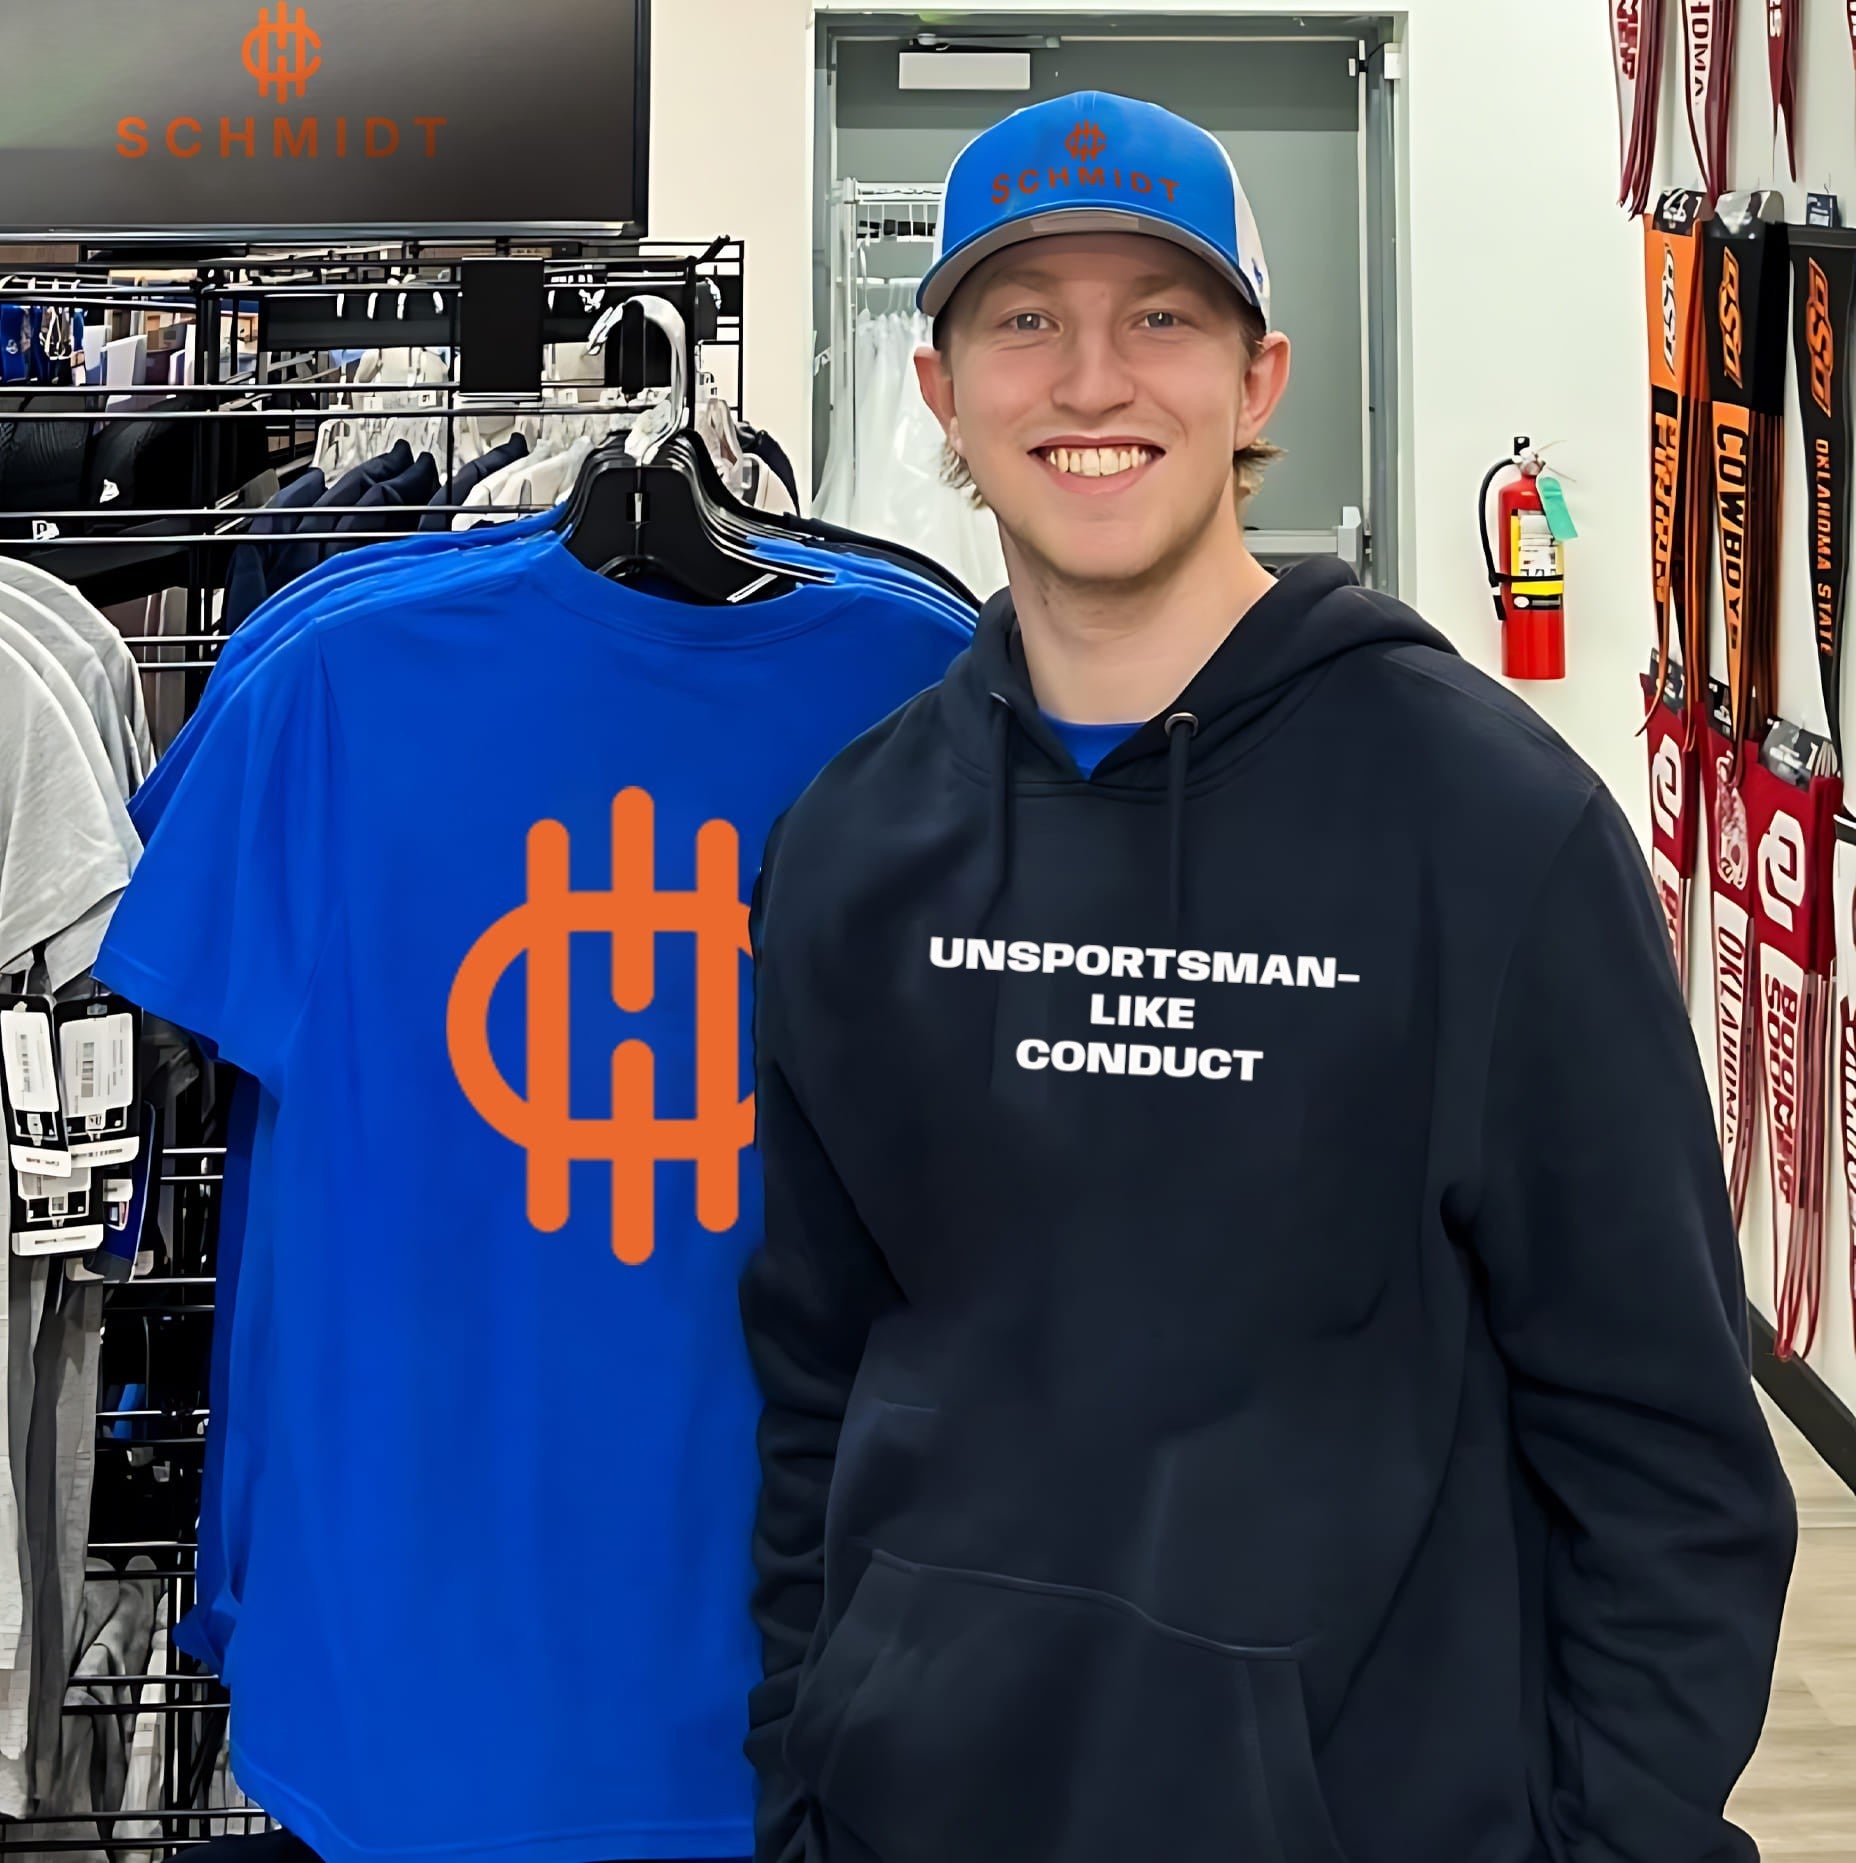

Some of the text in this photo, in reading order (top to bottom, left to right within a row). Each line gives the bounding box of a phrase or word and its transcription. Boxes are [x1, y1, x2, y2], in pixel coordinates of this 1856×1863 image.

[115, 116, 447, 159] SCHMIDT
[991, 167, 1179, 205] SCHMIDT
[1815, 438, 1832, 570] OKLAHOMA
[1716, 423, 1748, 650] COWBOY
[929, 936, 1360, 989] UNSPORTSMAN-
[1090, 993, 1196, 1030] LIKE
[1718, 926, 1745, 1144] OKLAHOMA
[1015, 1038, 1264, 1081] CONDUCT
